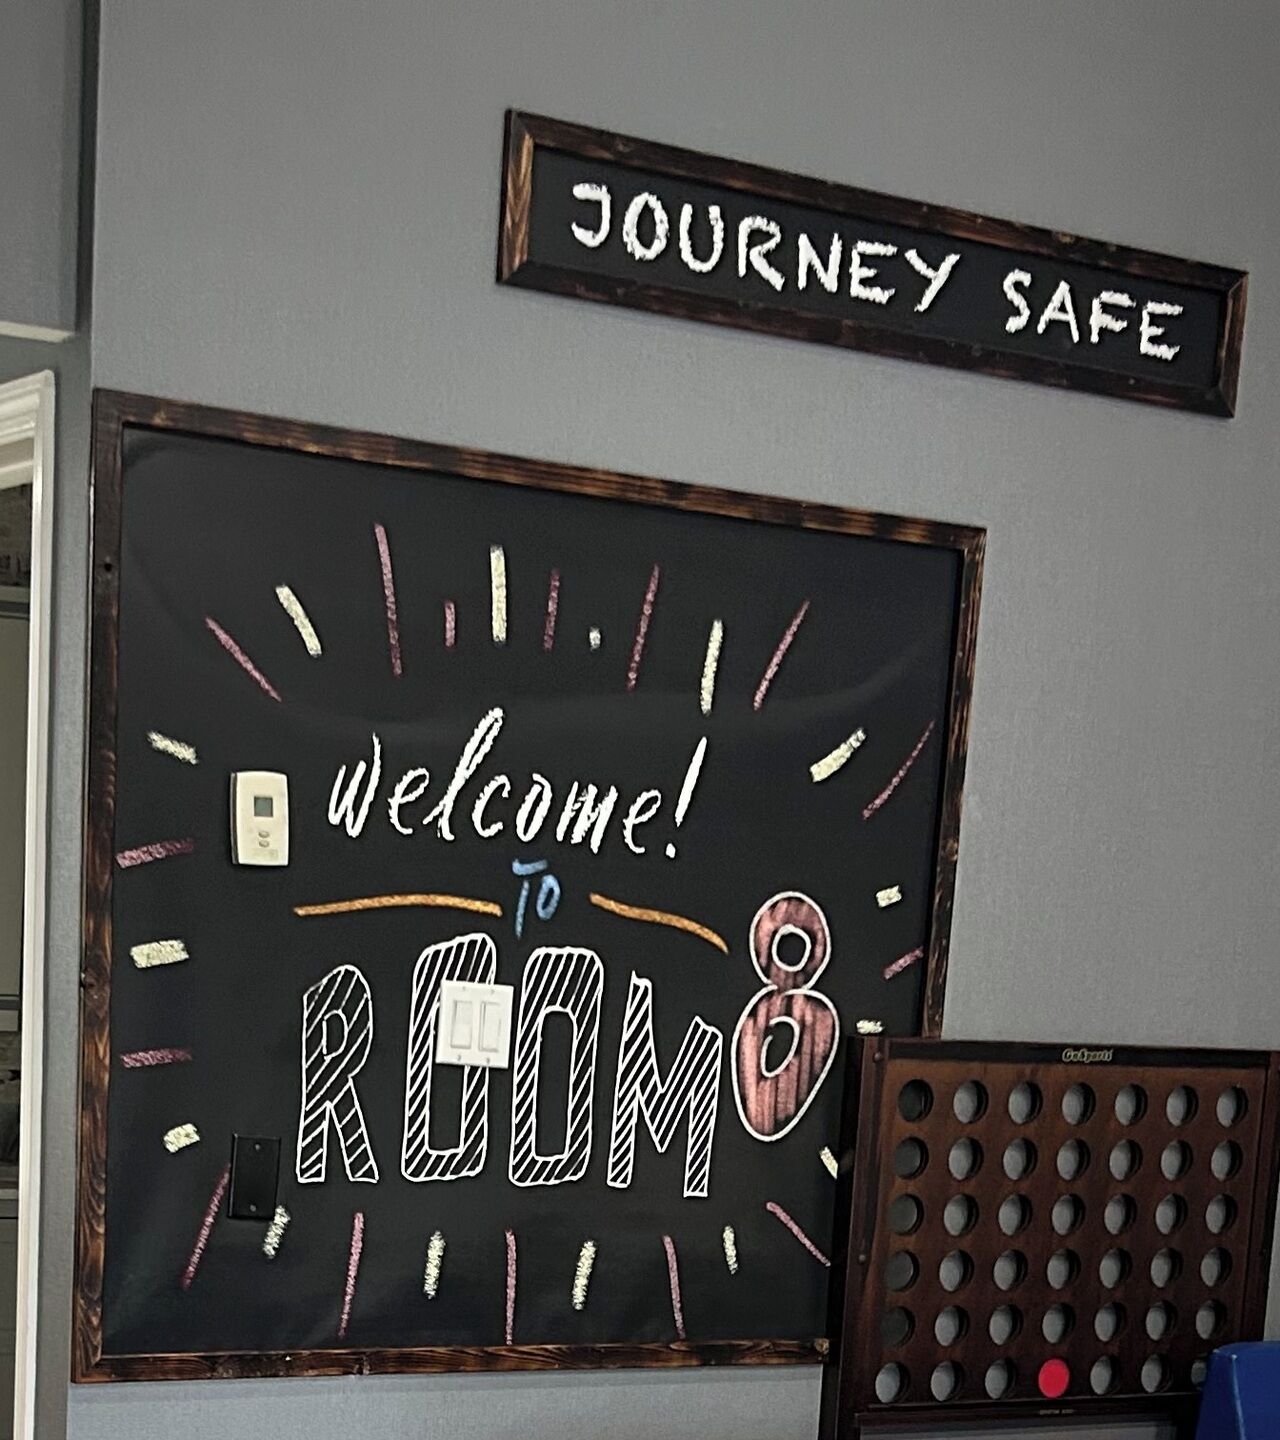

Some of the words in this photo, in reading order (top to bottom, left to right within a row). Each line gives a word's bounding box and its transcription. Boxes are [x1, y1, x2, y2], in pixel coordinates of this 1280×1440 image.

[570, 182, 962, 313] JOURNEY
[1001, 267, 1185, 362] SAFE
[294, 931, 724, 1199] ROOM
[729, 889, 841, 1144] 8
